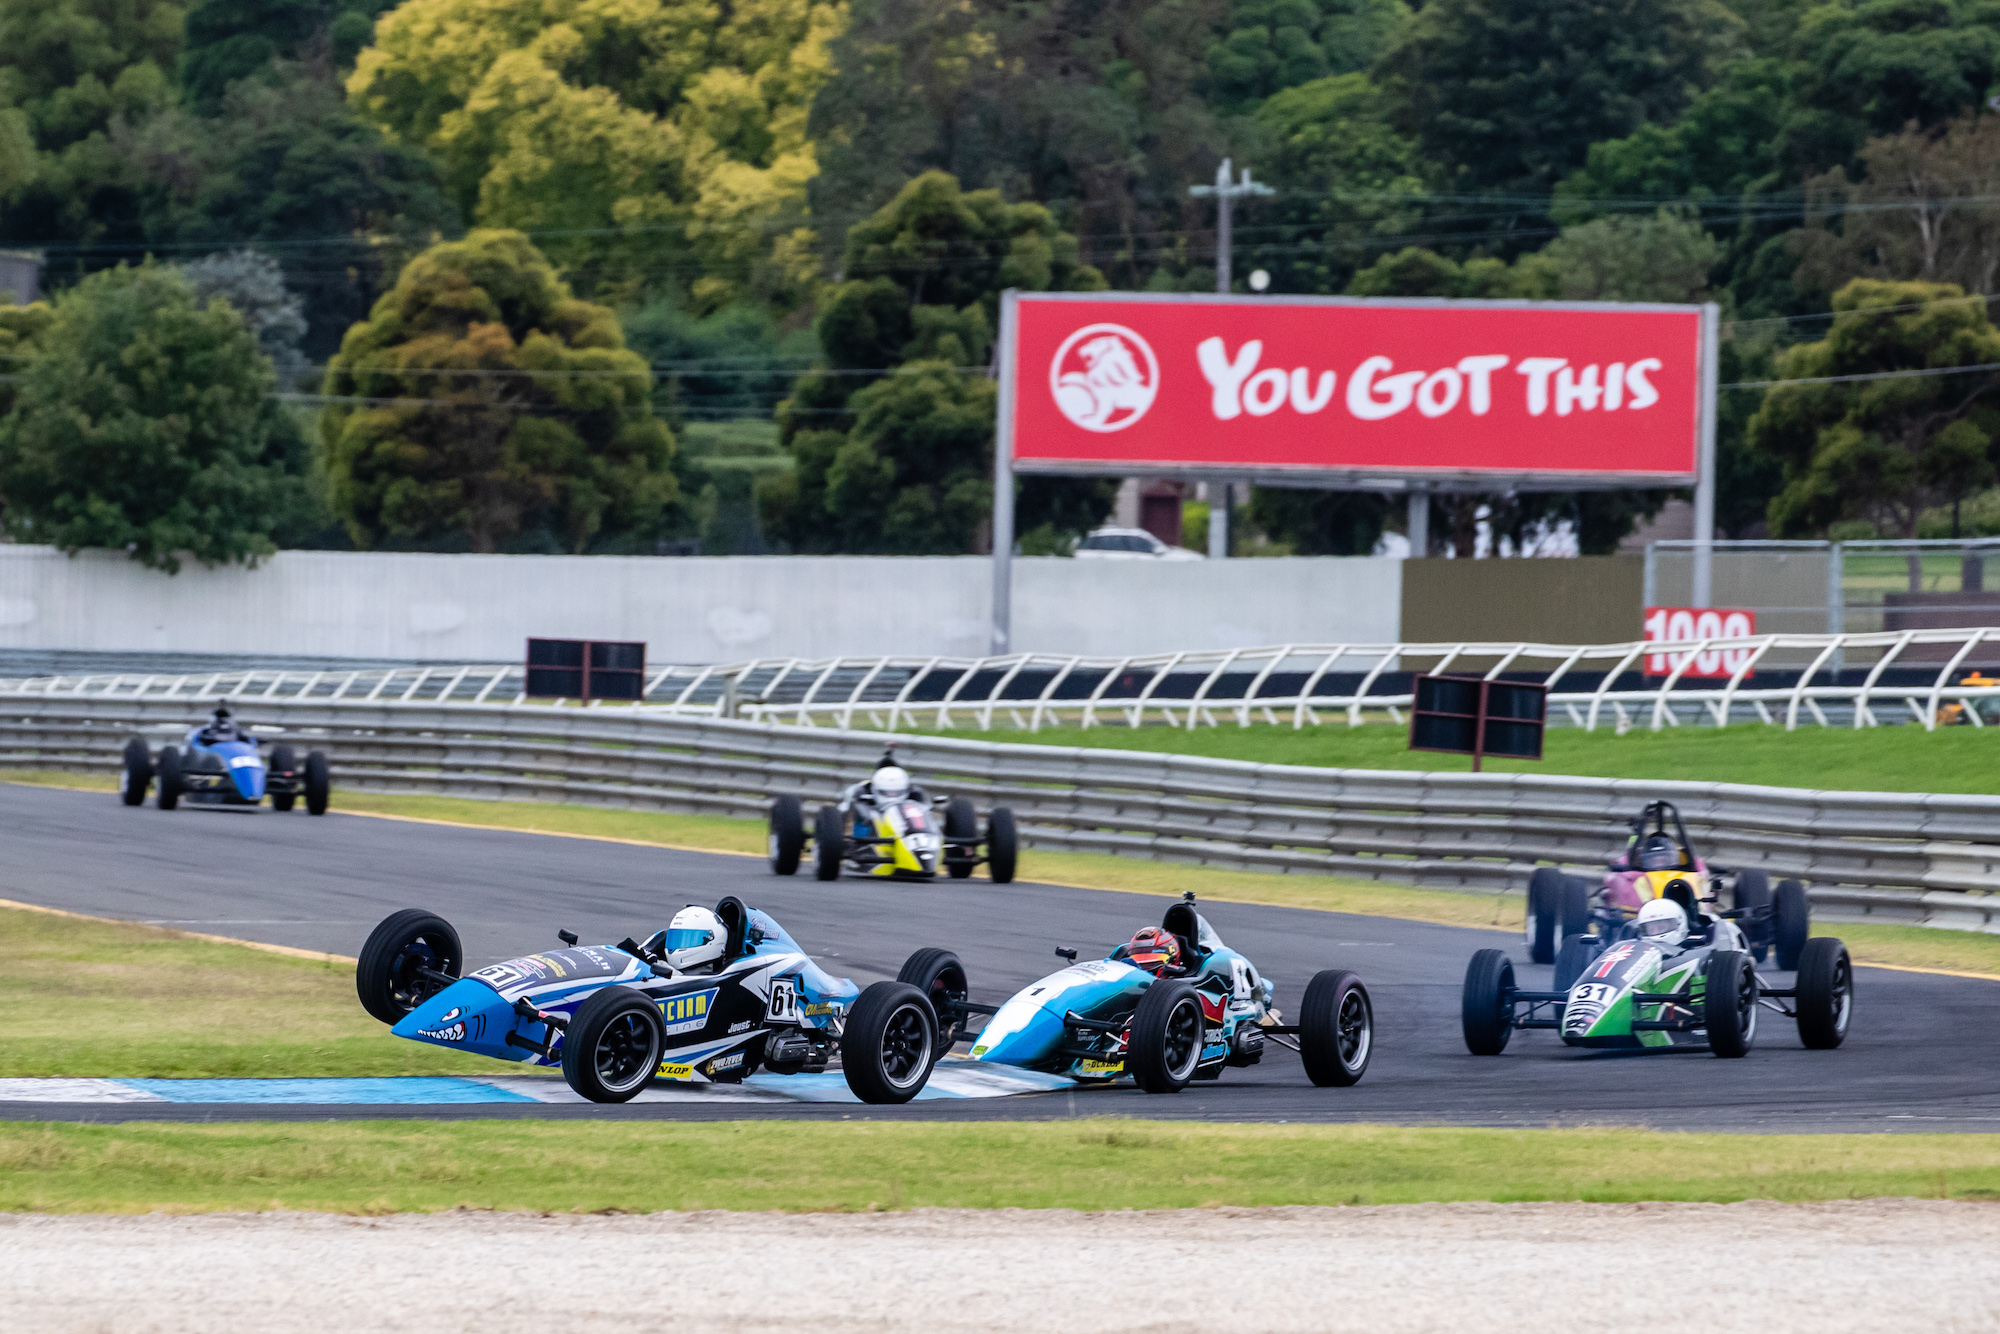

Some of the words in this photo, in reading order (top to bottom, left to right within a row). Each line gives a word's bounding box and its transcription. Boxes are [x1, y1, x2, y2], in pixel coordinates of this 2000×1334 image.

[1516, 357, 1662, 417] THIS
[1645, 609, 1750, 675] 1000
[476, 966, 516, 985] 61
[771, 985, 795, 1017] 61
[1576, 985, 1609, 1001] 31
[657, 1064, 689, 1076] NLOP
